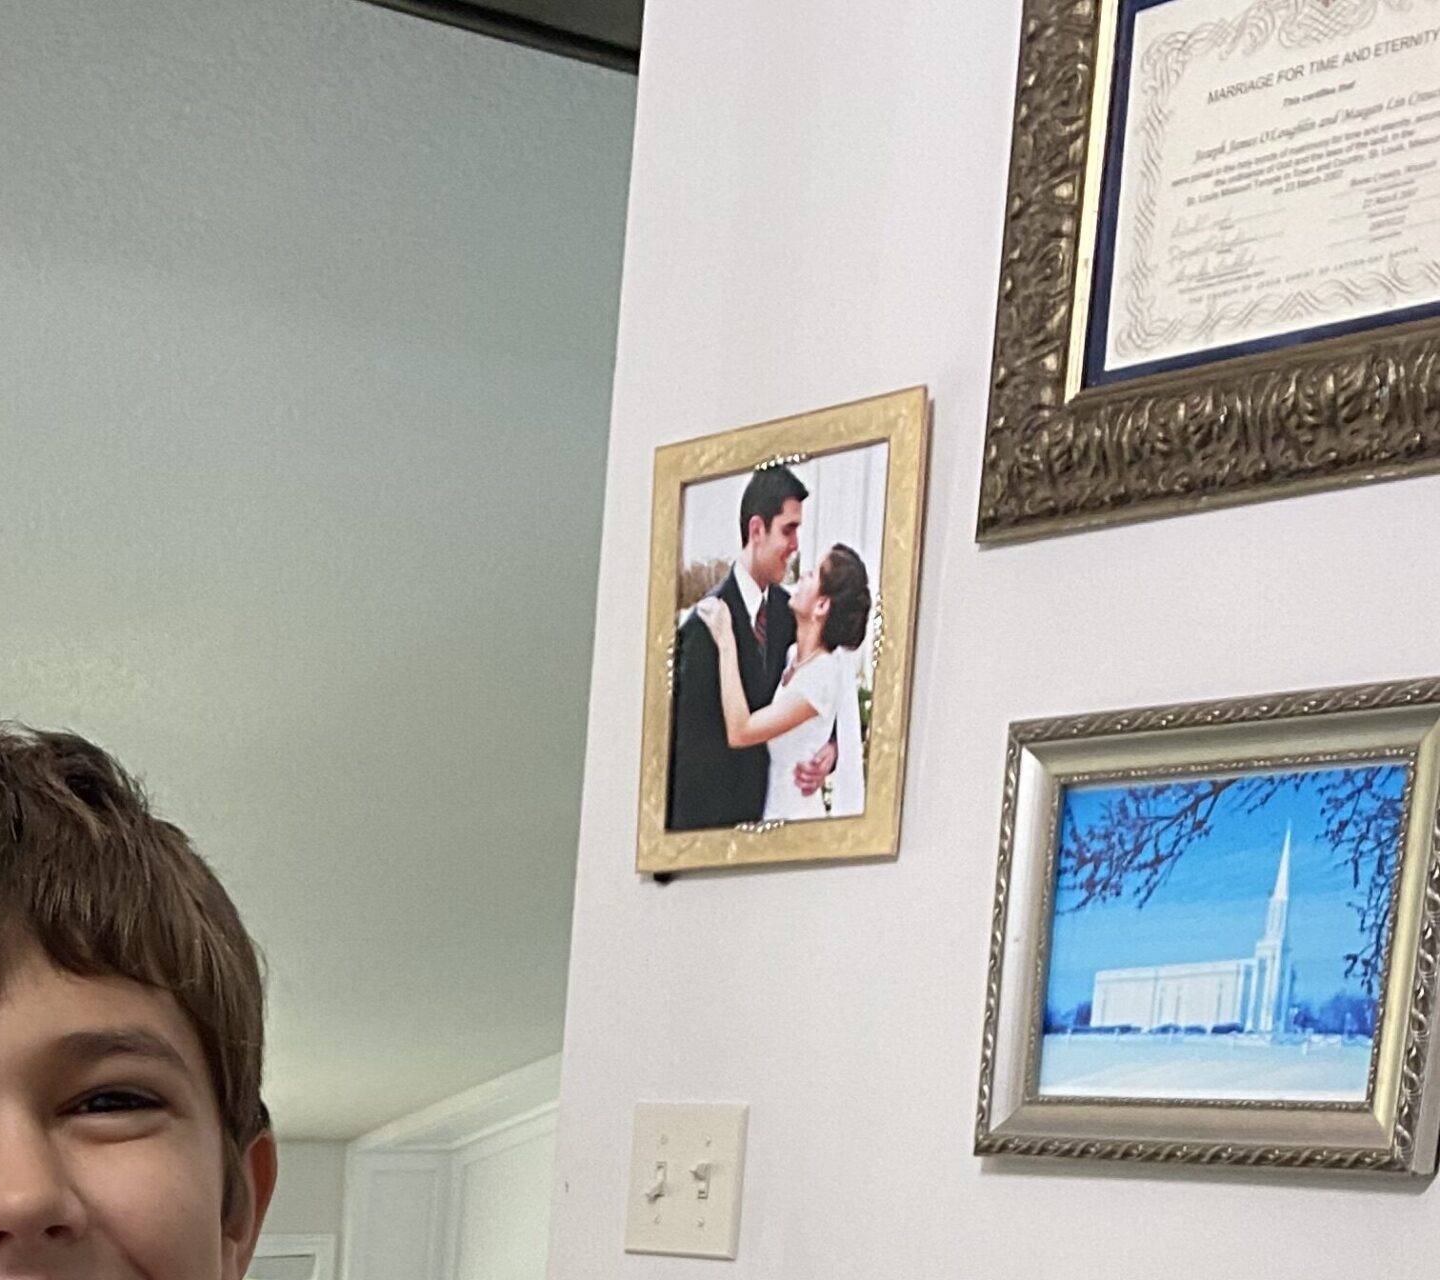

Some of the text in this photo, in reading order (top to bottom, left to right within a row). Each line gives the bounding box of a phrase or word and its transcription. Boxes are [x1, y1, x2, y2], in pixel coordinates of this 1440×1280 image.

[1208, 26, 1440, 105] MARRIAGE FOR TIME AND ETERNITY
